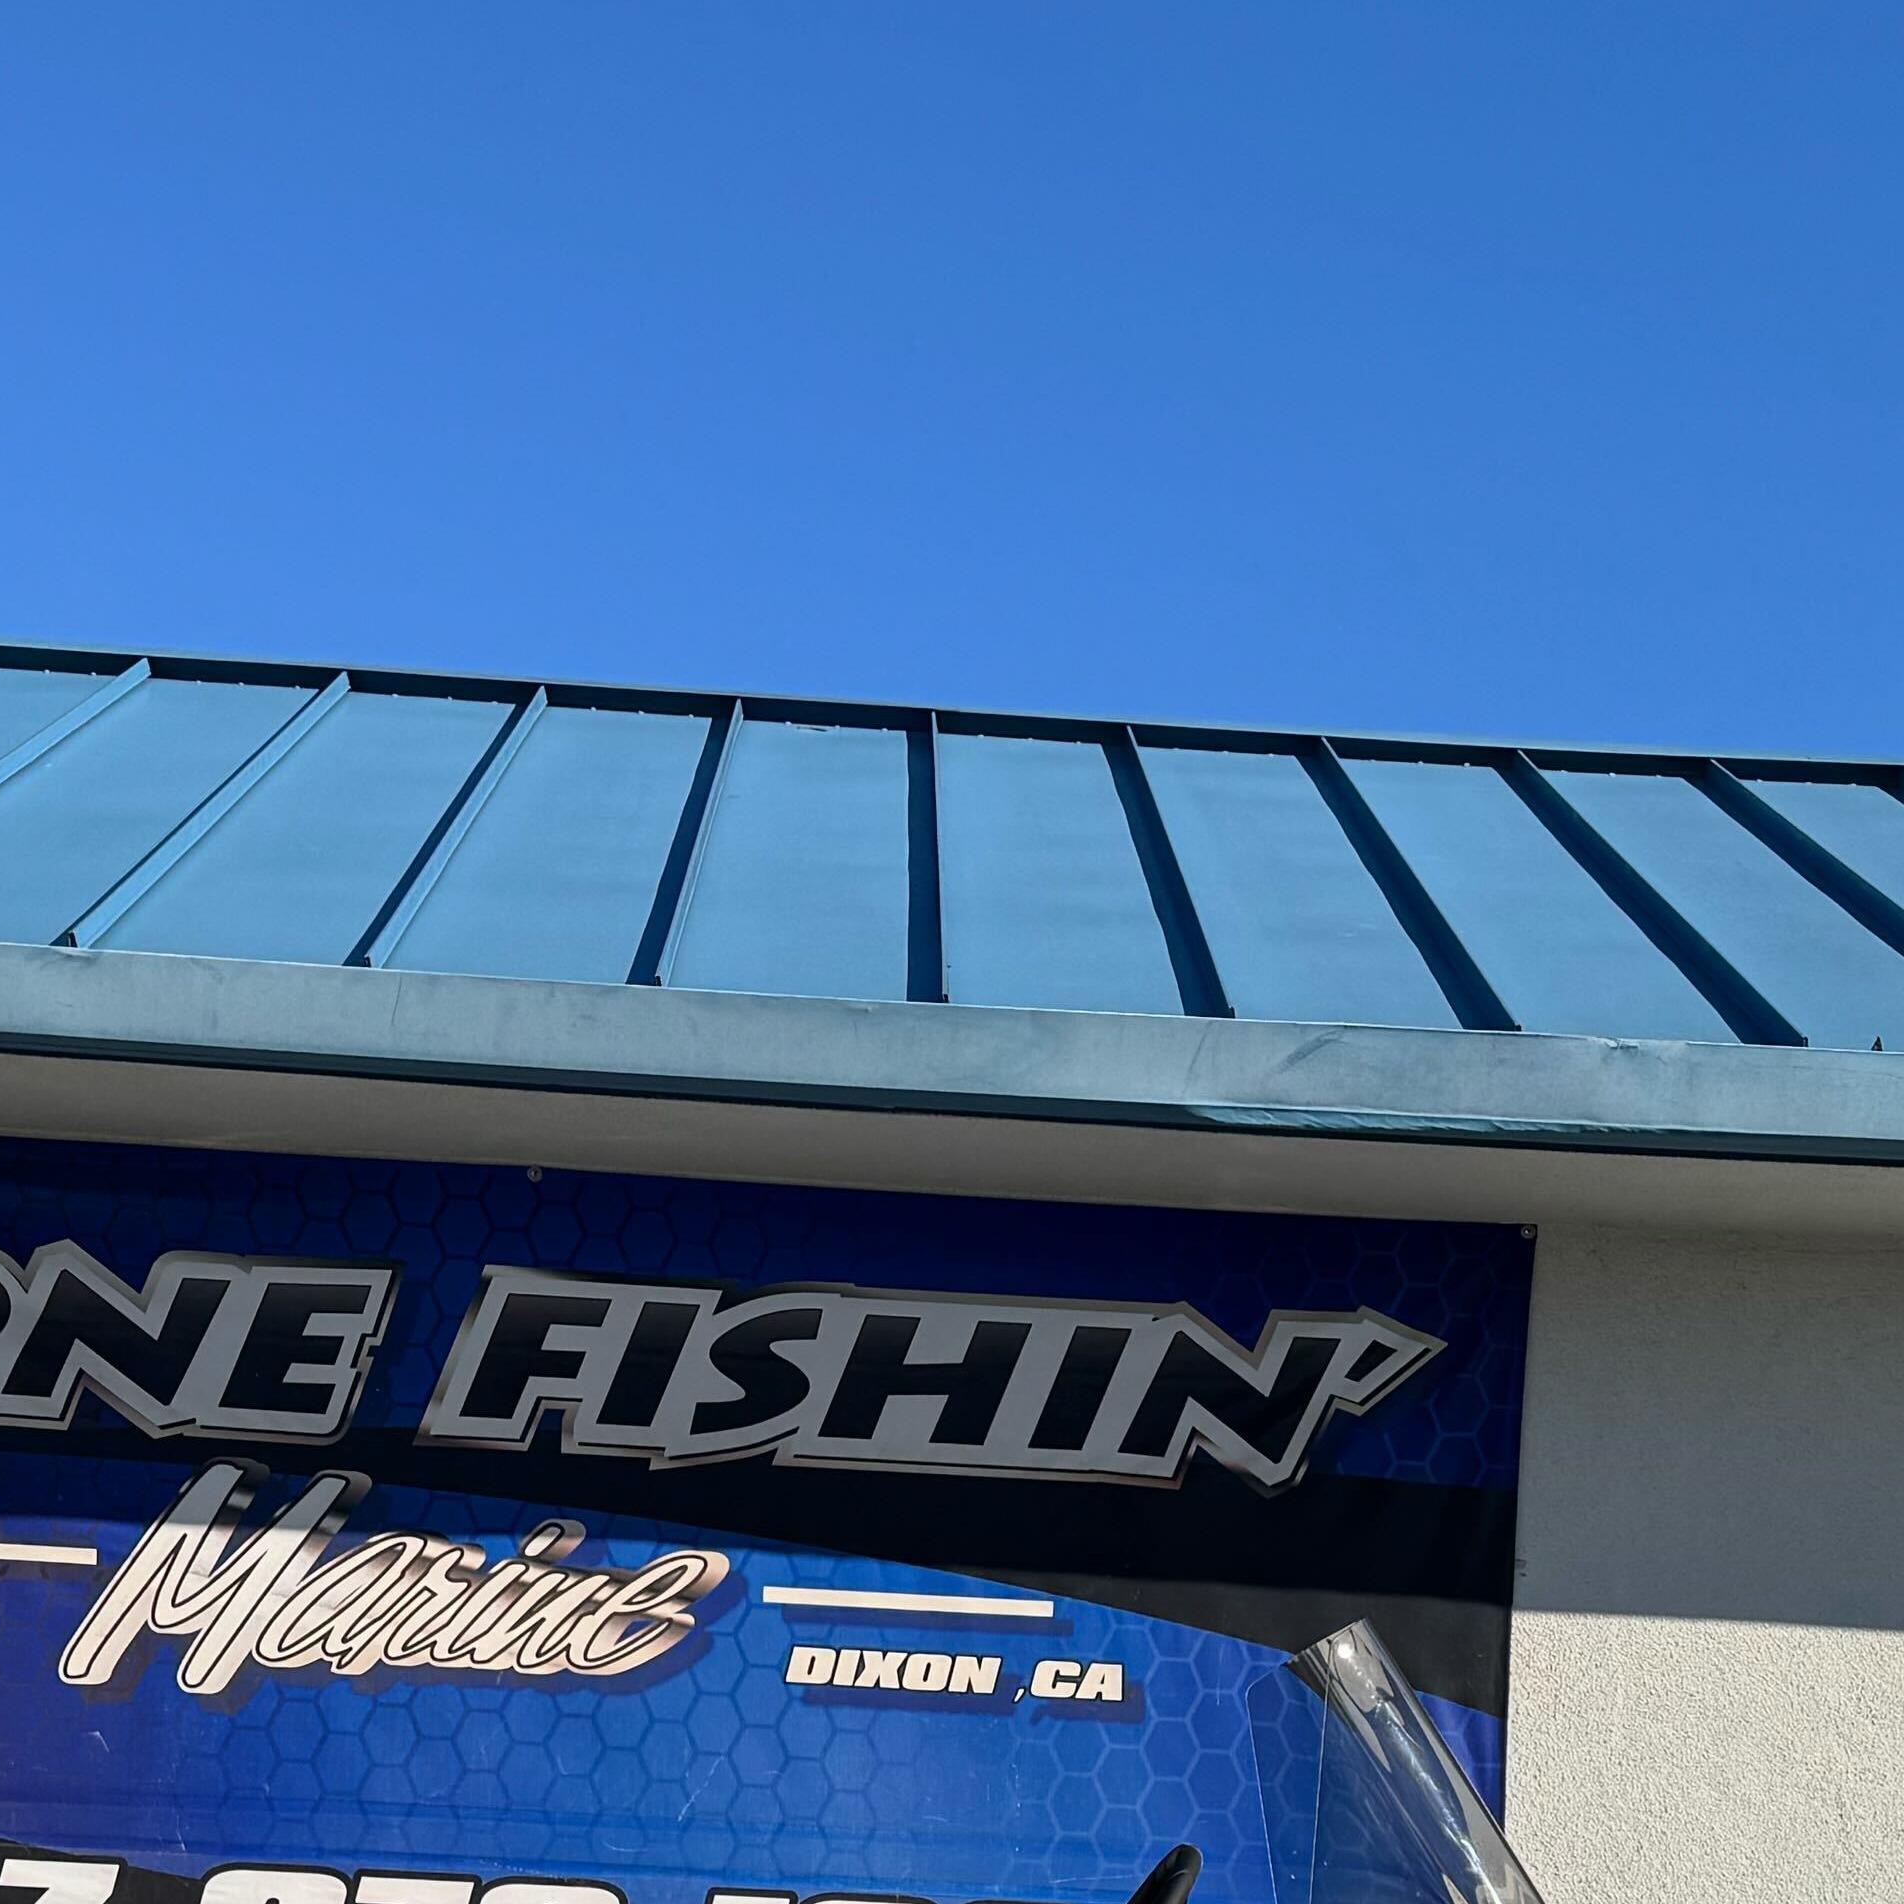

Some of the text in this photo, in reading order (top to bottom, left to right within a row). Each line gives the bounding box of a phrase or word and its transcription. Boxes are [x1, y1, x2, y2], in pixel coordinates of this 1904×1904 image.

[426, 1272, 1434, 1484] FISHIN'
[59, 1457, 729, 1693] Marine
[786, 1646, 1002, 1695] DIXON
